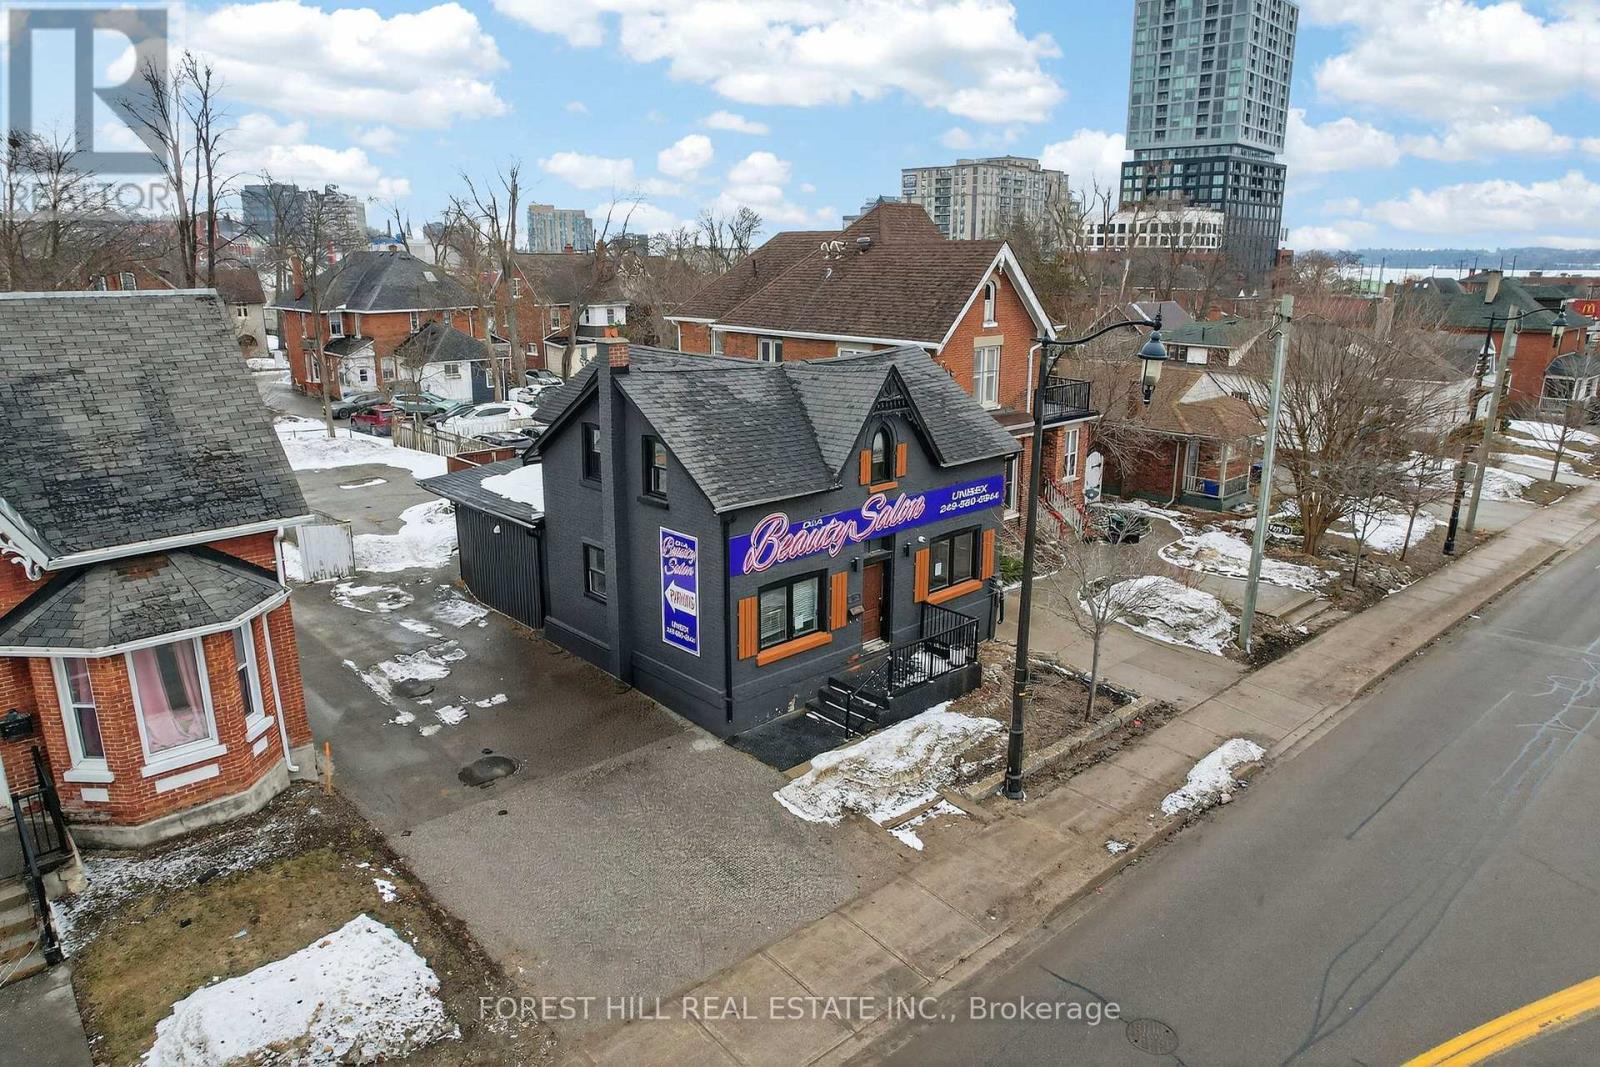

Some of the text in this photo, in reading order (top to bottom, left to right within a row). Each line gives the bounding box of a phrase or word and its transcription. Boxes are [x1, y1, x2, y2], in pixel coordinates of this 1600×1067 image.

[952, 484, 988, 500] UNISEX
[743, 493, 925, 574] Beauty Salon
[664, 558, 695, 577] Salon
